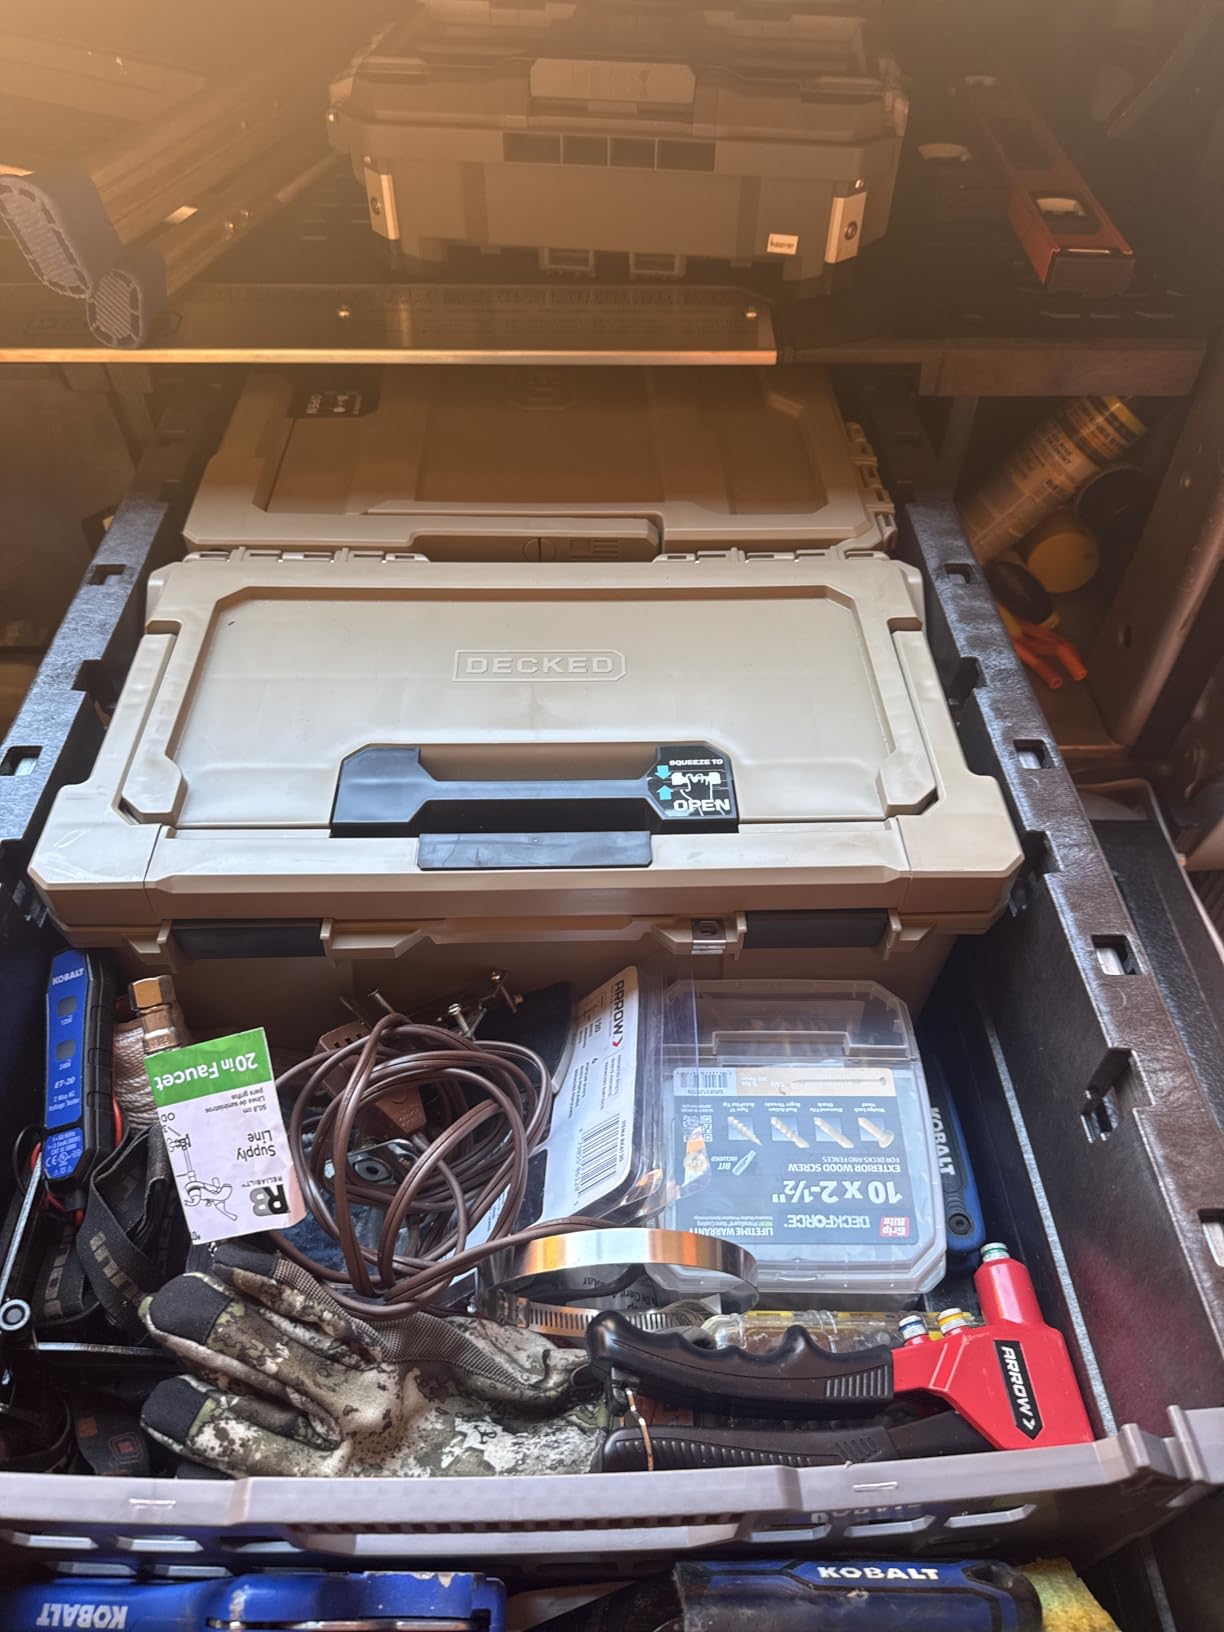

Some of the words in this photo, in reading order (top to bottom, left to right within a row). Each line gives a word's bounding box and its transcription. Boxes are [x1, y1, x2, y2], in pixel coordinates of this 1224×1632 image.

[466, 657, 613, 674] DECKED
[674, 798, 730, 812] OPEN
[52, 968, 84, 985] KOBALT
[613, 980, 625, 1036] ARROW
[220, 1058, 235, 1073] in
[235, 1052, 258, 1071] 20
[155, 1063, 219, 1090] Faucet
[248, 1130, 273, 1142] Line
[930, 1106, 956, 1176] KOBALT
[236, 1144, 276, 1162] Supply
[788, 1164, 821, 1172] SCREW
[823, 1164, 853, 1172] WOOD
[854, 1164, 900, 1172] EXTERIOR
[868, 1180, 902, 1204] 10
[786, 1214, 870, 1228] DECKFORCE
[735, 1228, 773, 1236] LIFETIME
[882, 1225, 905, 1236] Grip
[1000, 1346, 1033, 1416] ARROW
[816, 1566, 939, 1580] KOBALT
[36, 1602, 128, 1630] KOBALT
